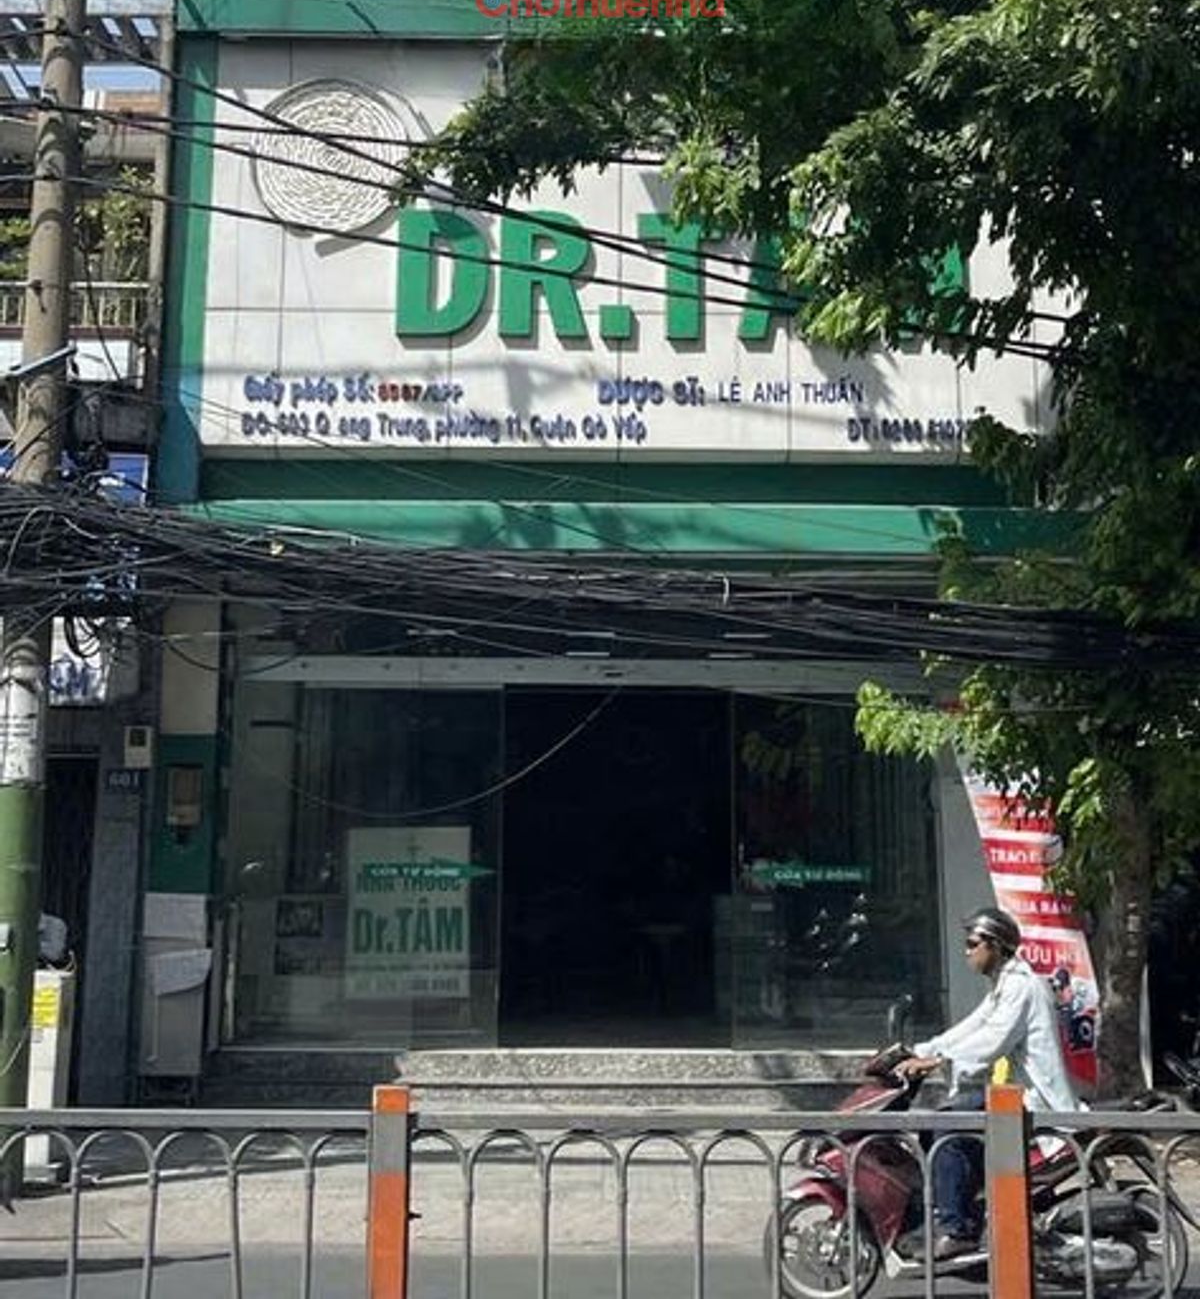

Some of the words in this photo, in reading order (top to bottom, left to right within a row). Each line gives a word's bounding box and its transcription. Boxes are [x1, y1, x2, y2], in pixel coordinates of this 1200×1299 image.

[291, 376, 338, 408] phép
[718, 376, 742, 402] LÊ
[753, 381, 790, 402] ANH
[353, 897, 464, 953] Dr.TÂM
